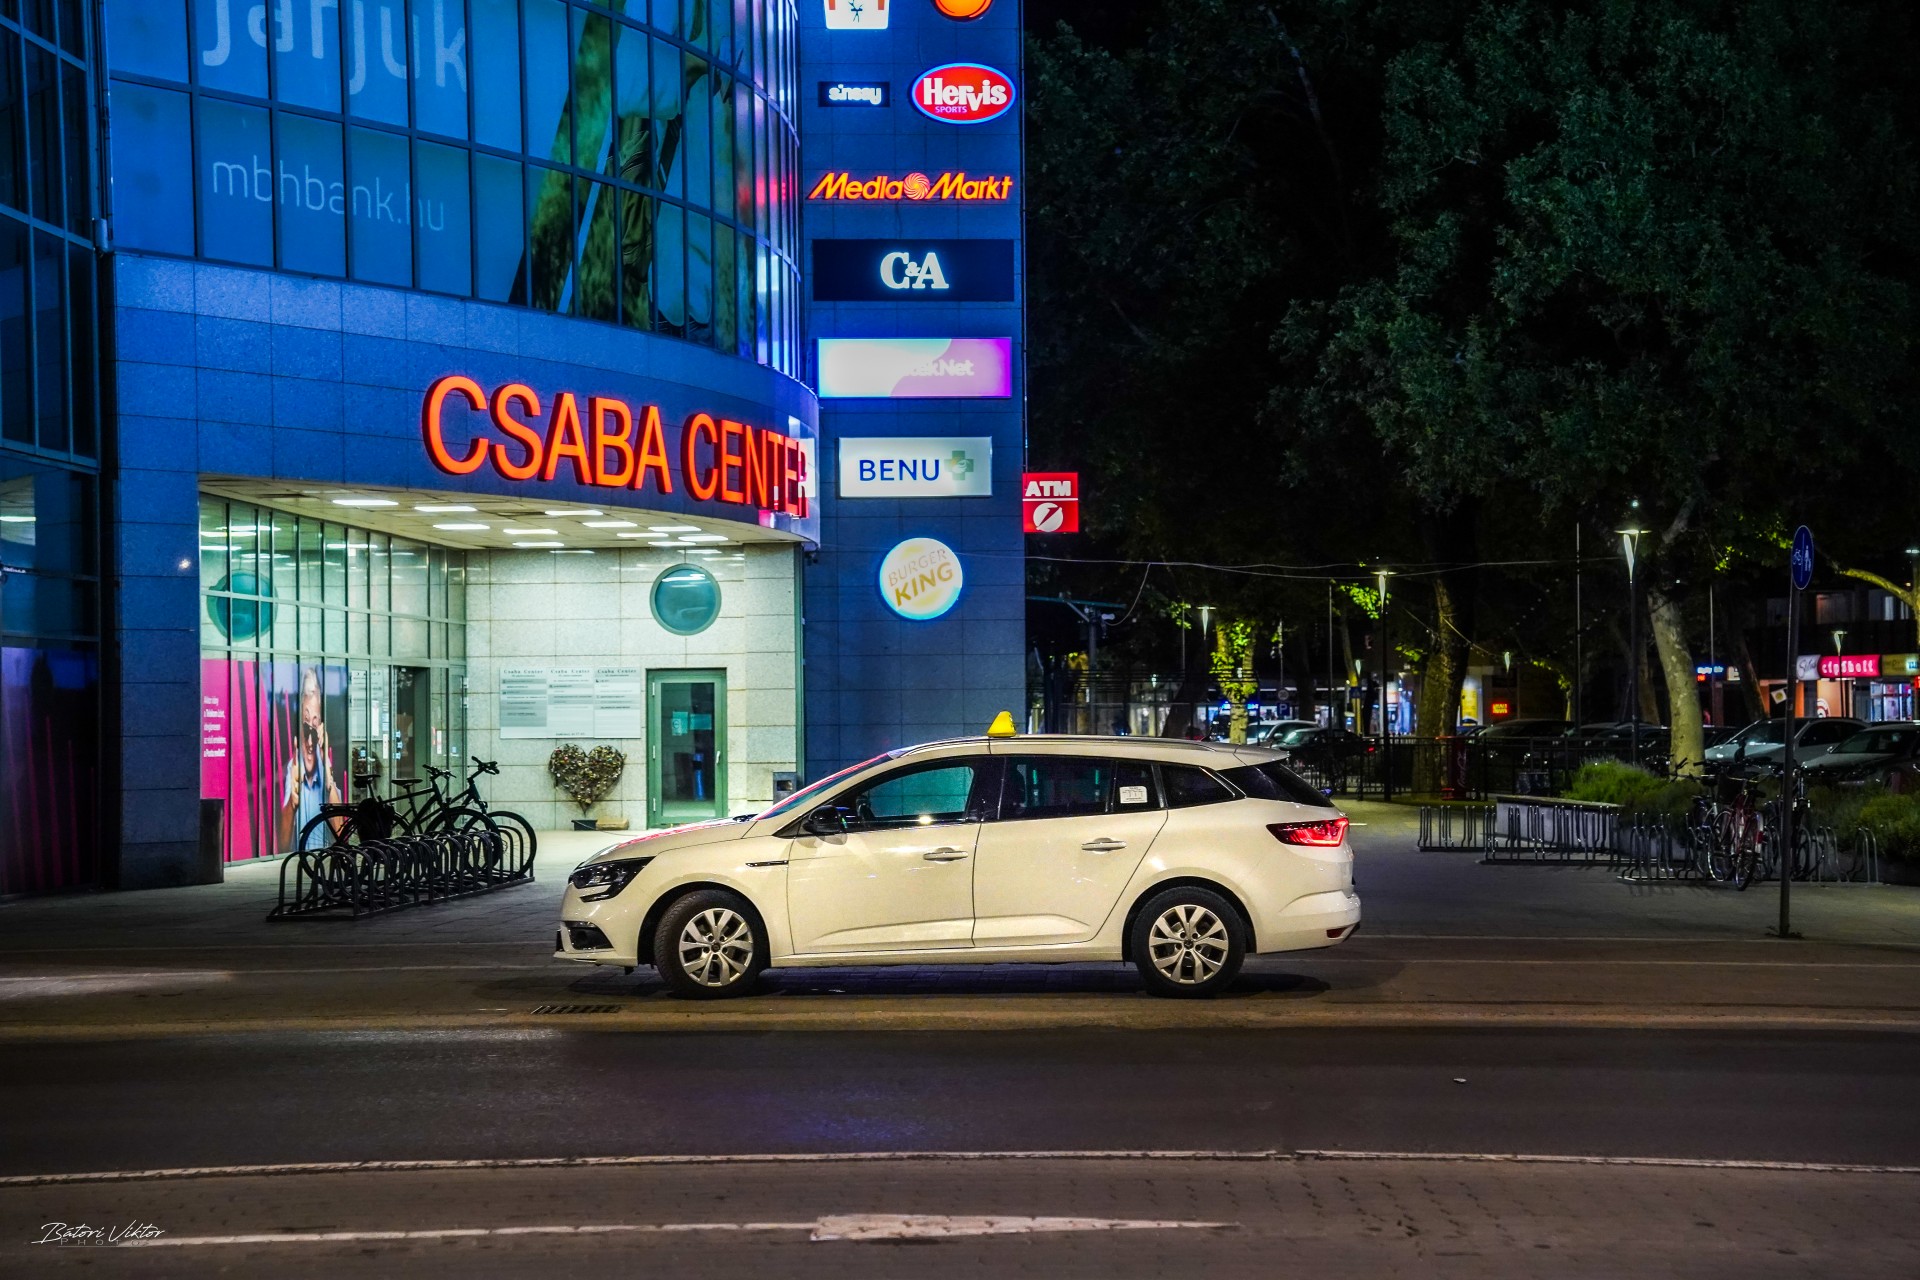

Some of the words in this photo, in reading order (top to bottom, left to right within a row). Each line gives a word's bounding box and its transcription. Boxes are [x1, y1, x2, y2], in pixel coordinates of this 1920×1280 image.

[923, 78, 1008, 111] Hervis
[935, 106, 967, 114] SPORTS
[213, 155, 444, 231] mbhbank.hu
[880, 252, 949, 289] C&A
[422, 375, 673, 494] CSABA
[681, 413, 809, 519] CENTER
[859, 459, 940, 481] BENU
[1025, 480, 1072, 497] ATM
[888, 548, 947, 587] BURGER
[895, 561, 953, 607] KING
[1279, 703, 1288, 715] P
